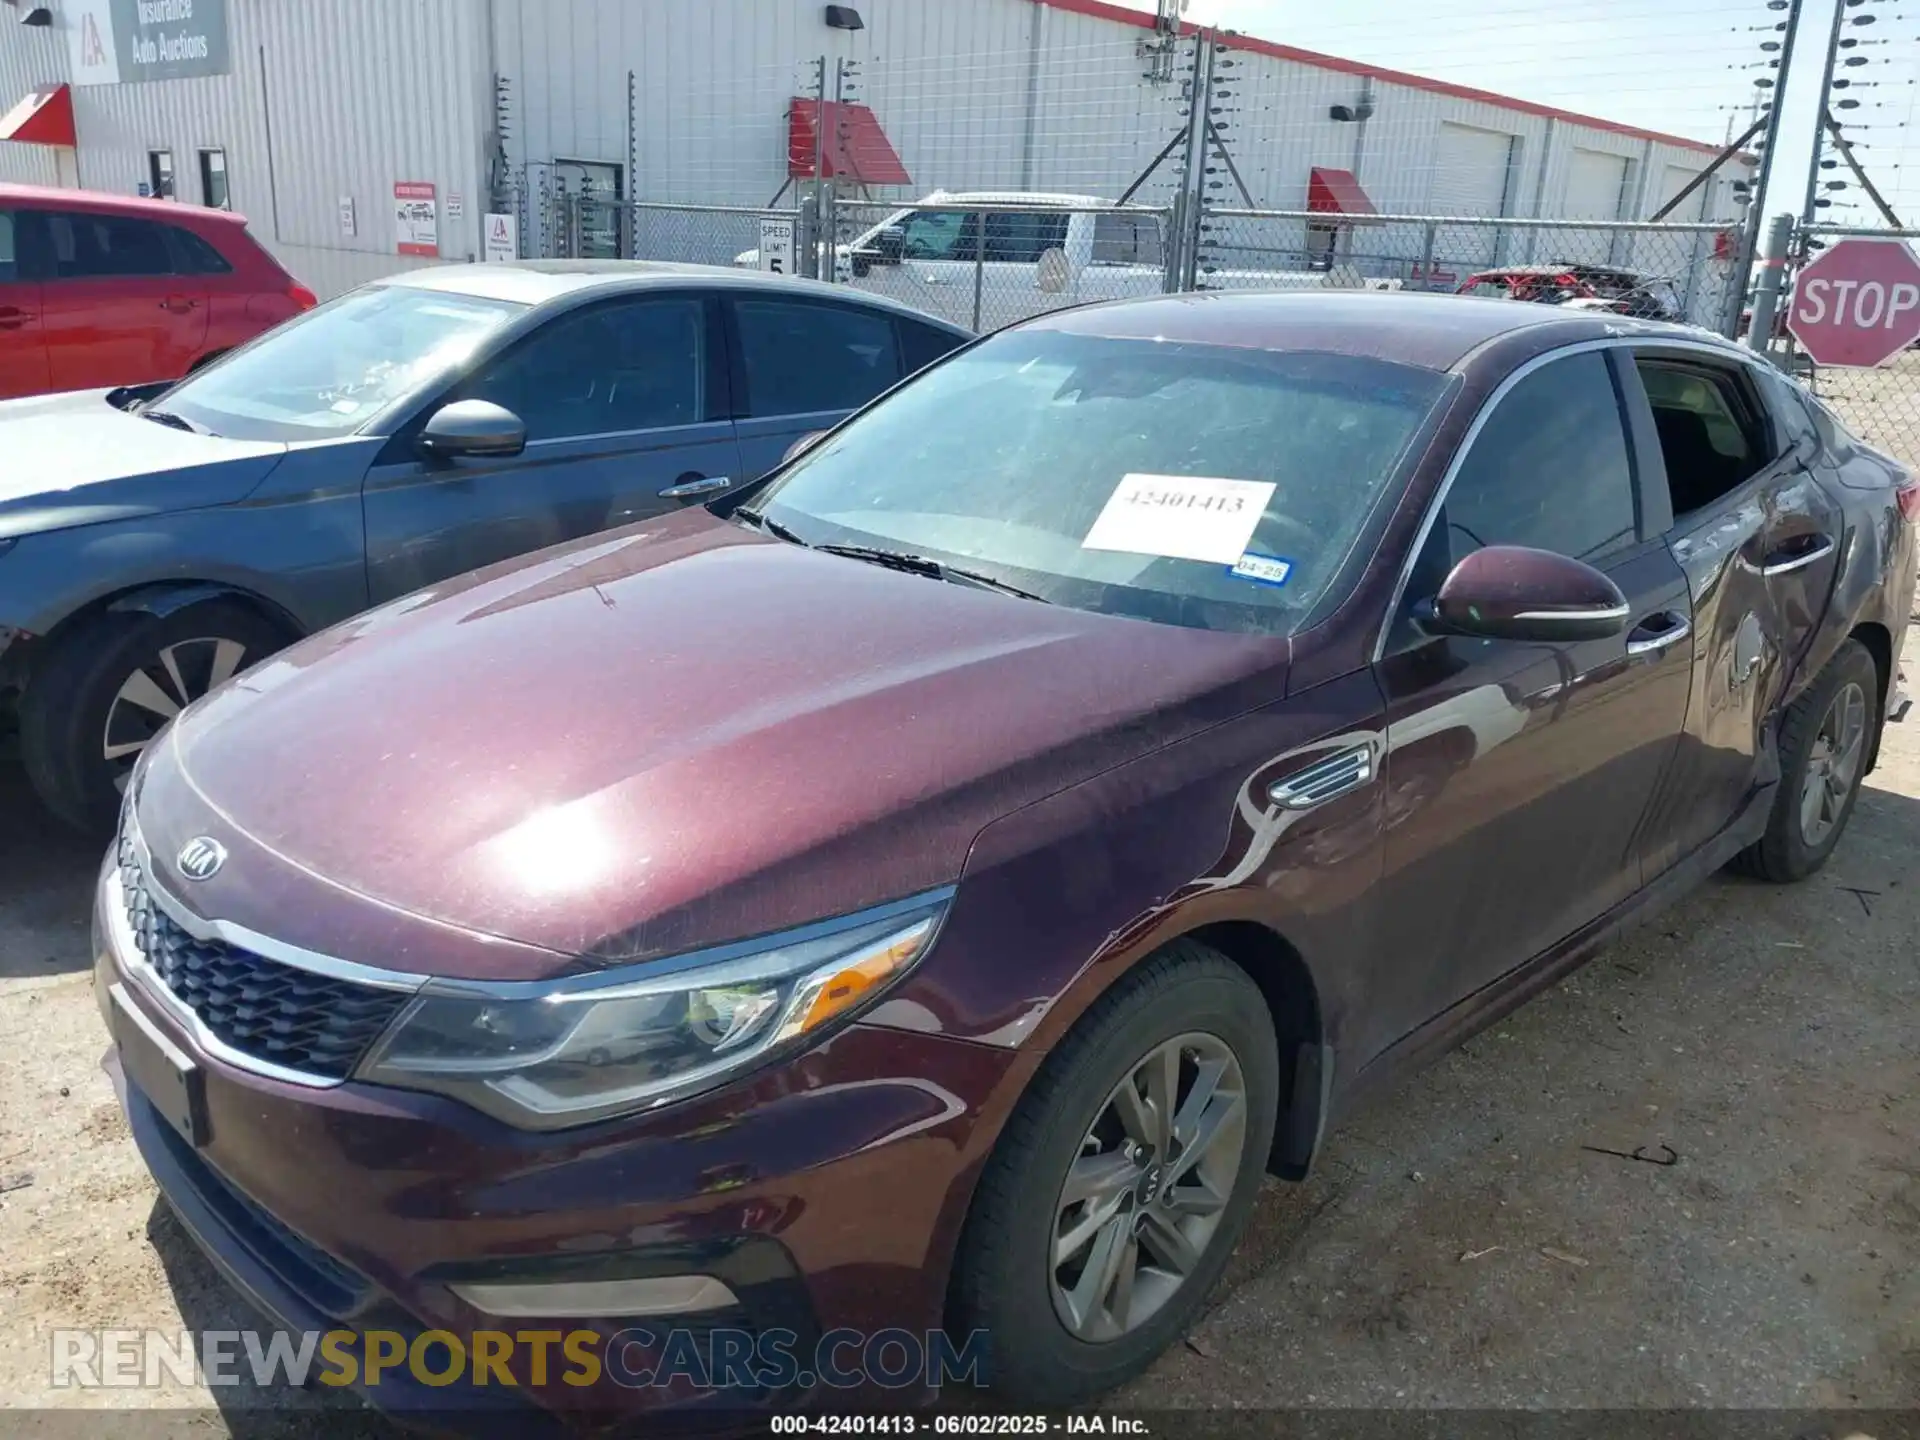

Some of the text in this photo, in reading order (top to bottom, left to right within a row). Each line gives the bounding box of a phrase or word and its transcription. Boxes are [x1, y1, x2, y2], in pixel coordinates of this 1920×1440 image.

[137, 0, 192, 24] Insurance
[133, 30, 208, 64] Auto Auctions
[762, 226, 790, 237] SPEED
[764, 241, 787, 253] LIMIT
[771, 258, 783, 274] 5
[1799, 278, 1920, 329] STOP
[1125, 491, 1244, 512] 42401413
